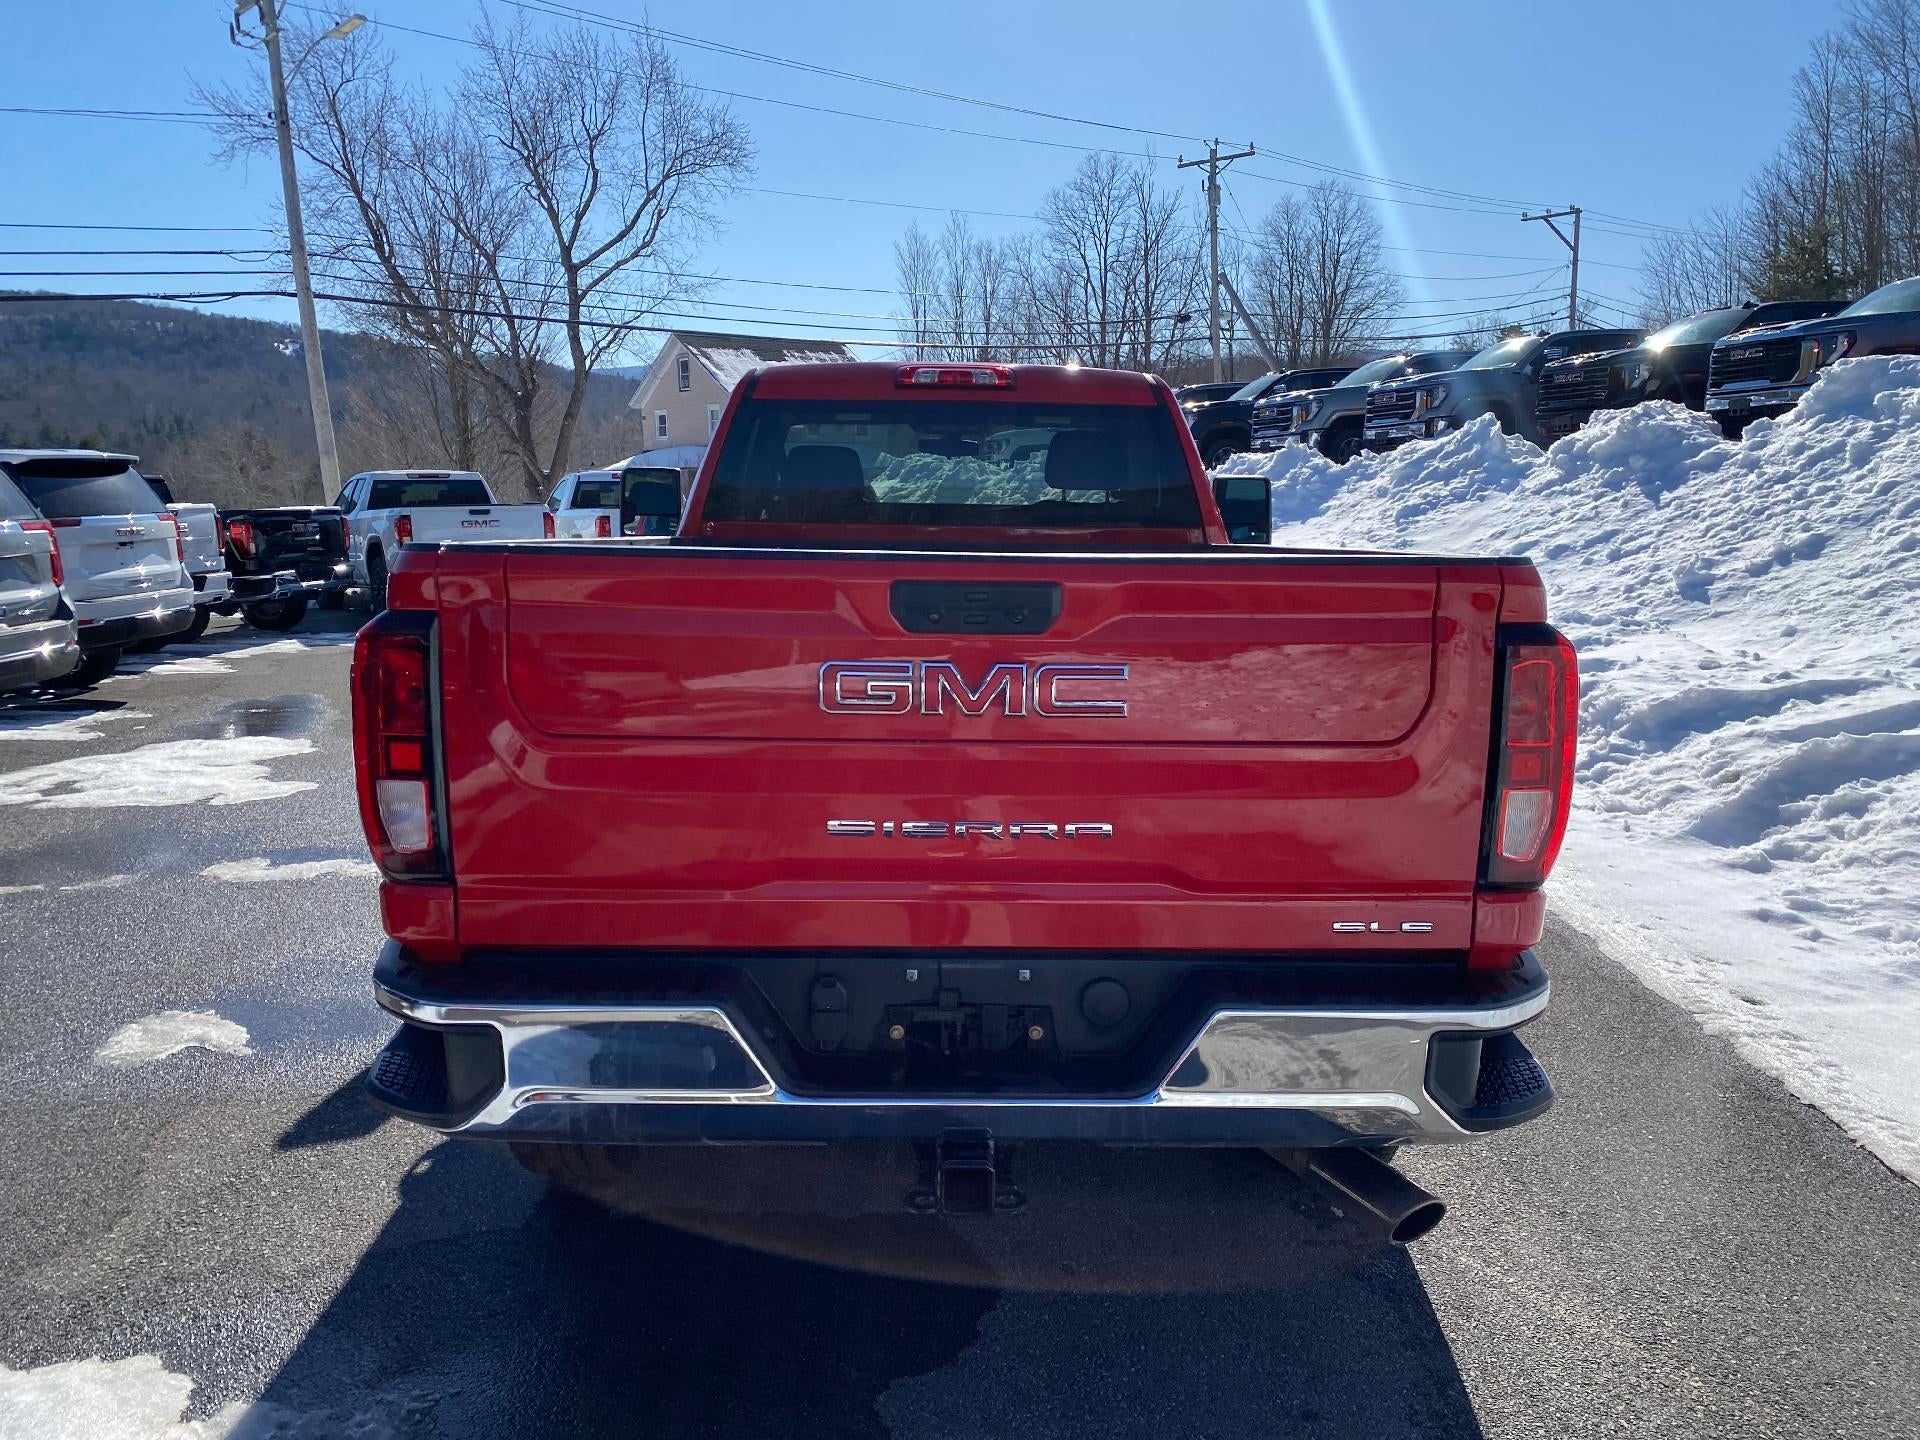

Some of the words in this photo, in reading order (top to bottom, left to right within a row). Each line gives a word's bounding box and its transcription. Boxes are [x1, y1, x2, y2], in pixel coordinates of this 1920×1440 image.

[461, 520, 500, 528] GMC
[818, 660, 1129, 717] GMC
[826, 820, 1113, 839] SIERRA
[1332, 922, 1434, 932] SLE
